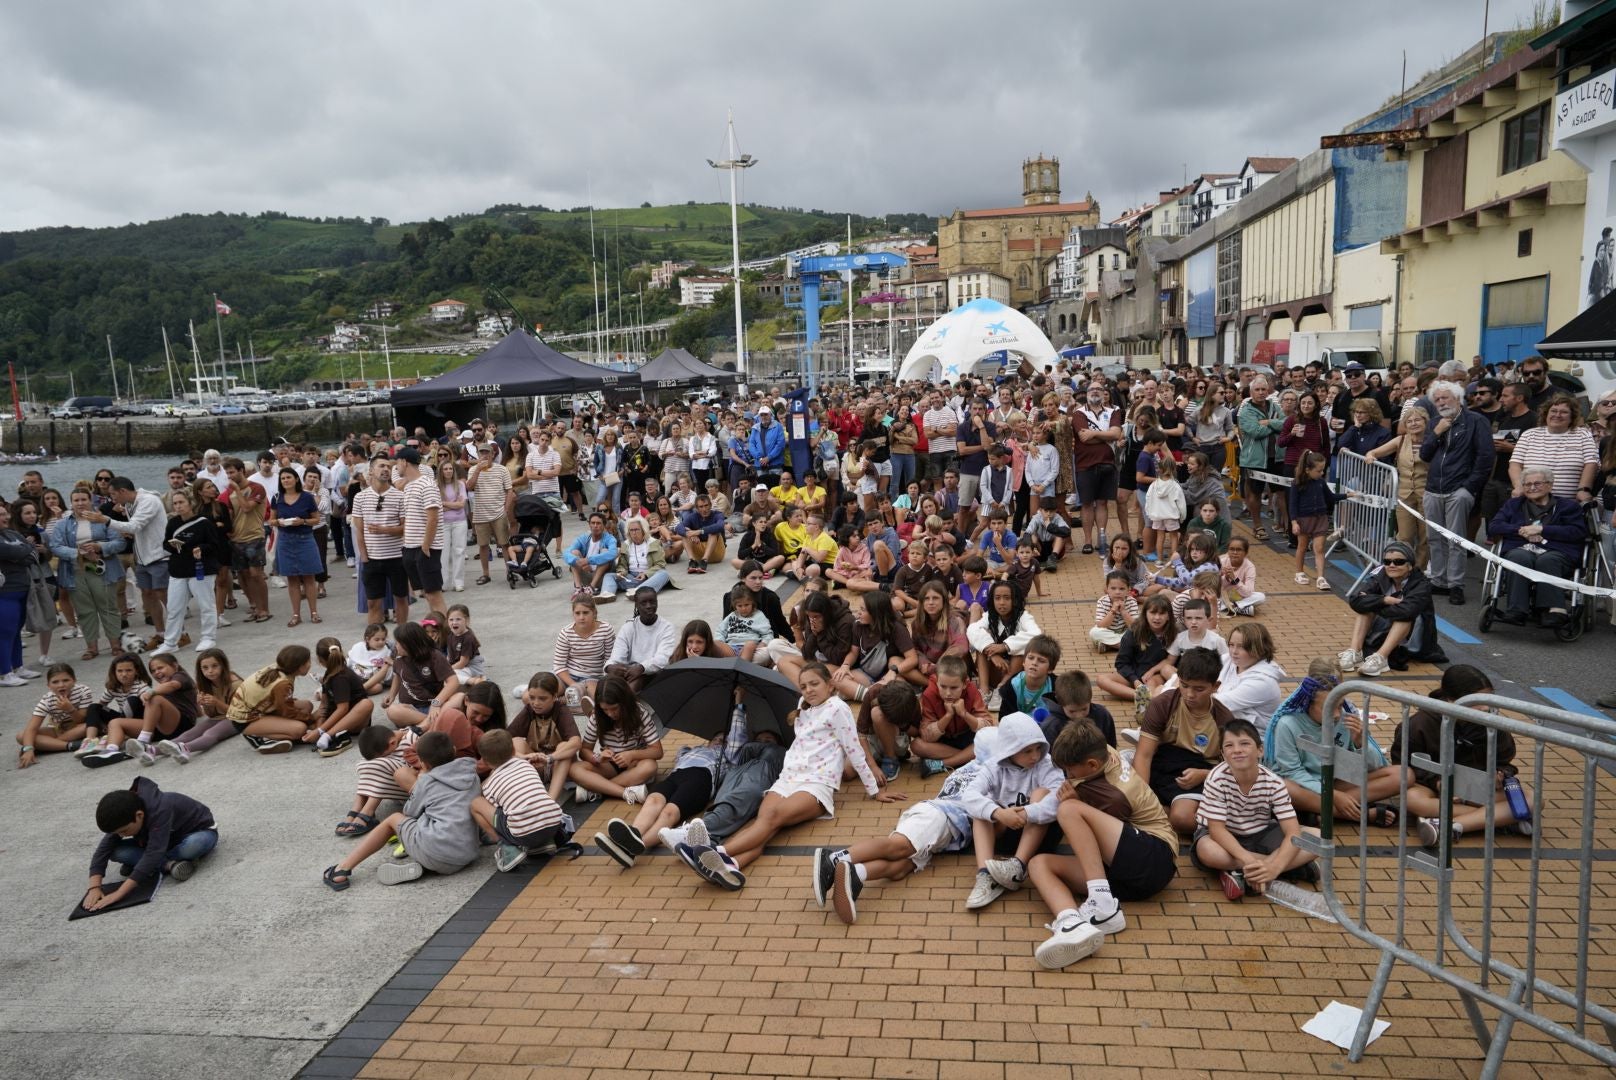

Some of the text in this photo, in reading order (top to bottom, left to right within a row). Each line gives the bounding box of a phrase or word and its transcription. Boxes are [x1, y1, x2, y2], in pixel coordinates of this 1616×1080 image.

[1558, 81, 1613, 127] ASTILLERO
[1572, 109, 1597, 127] ASADOR
[982, 336, 1019, 344] CaixaBank
[459, 383, 501, 394] KELER
[795, 400, 803, 412] P
